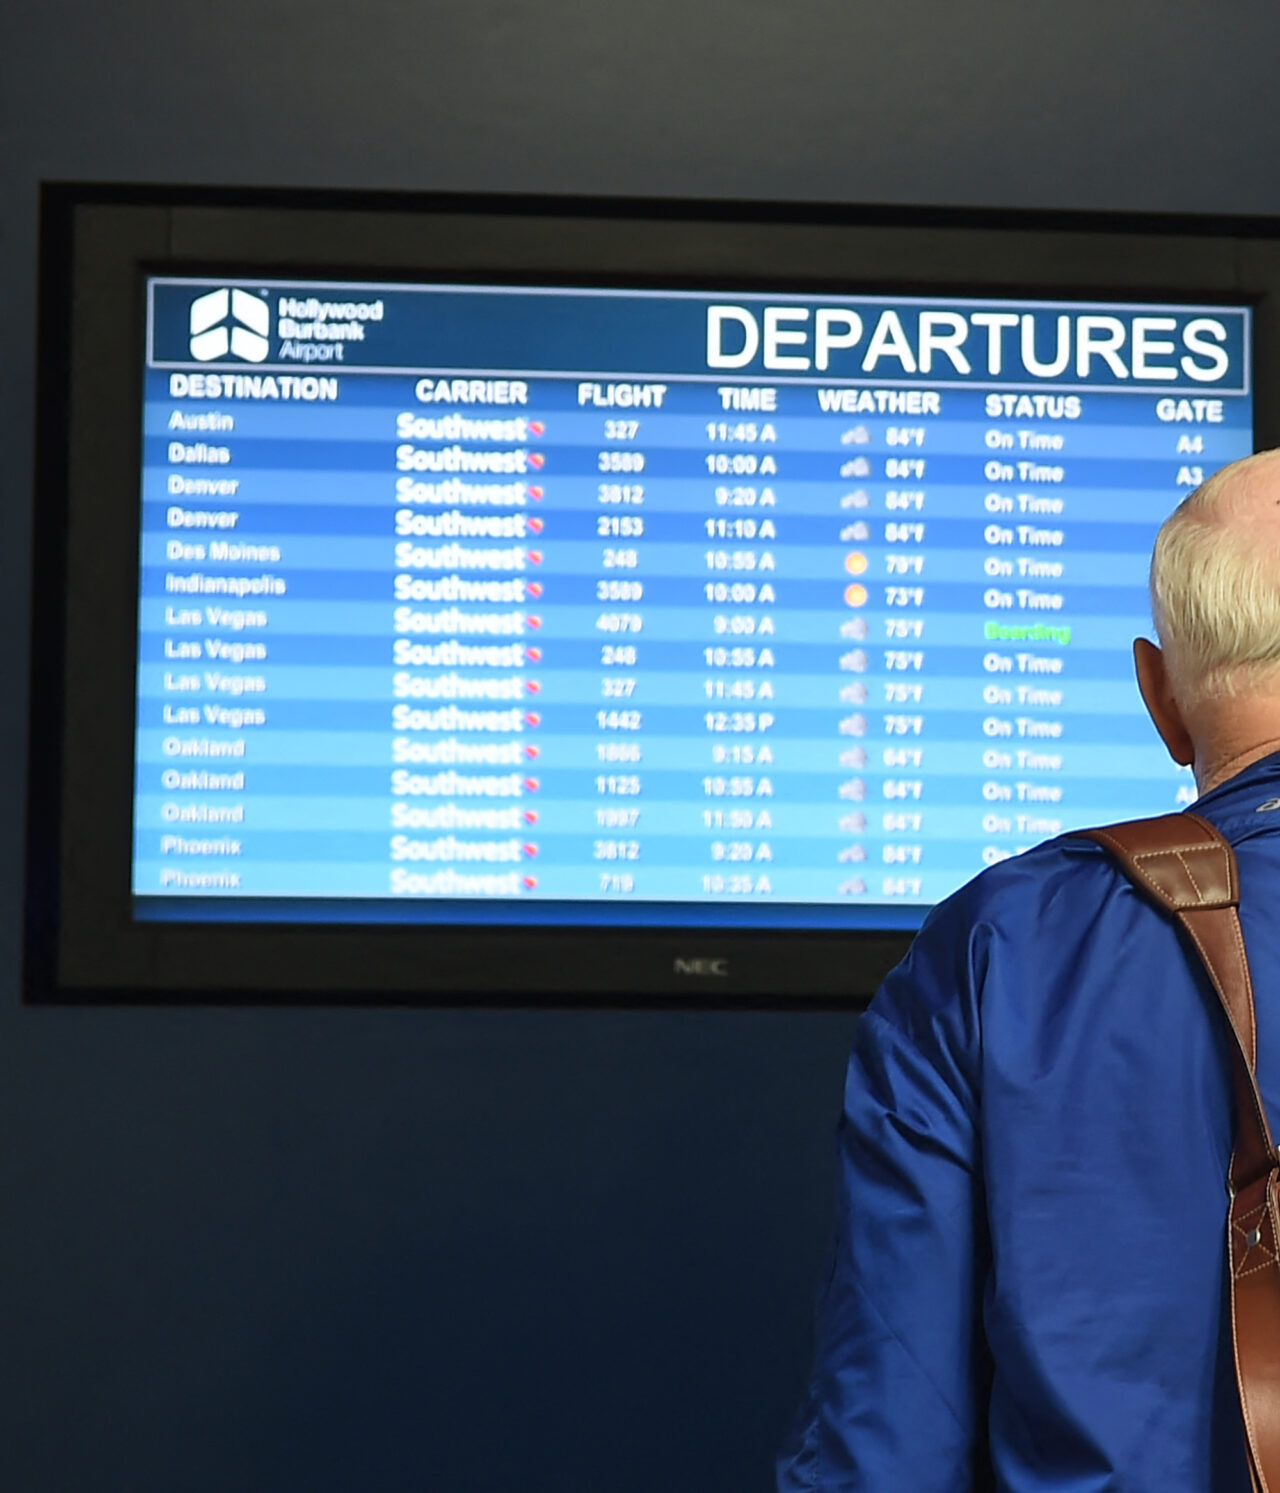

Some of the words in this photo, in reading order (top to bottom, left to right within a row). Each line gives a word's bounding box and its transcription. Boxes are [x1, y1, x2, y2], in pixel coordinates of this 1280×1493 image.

[279, 297, 384, 321] Hollywood
[278, 318, 365, 340] Burbank
[279, 339, 344, 362] Airport
[706, 304, 1229, 381] DEPARTURES
[171, 374, 337, 399] DESTINATION
[416, 380, 527, 403] CARRIER
[579, 383, 667, 407] FLIGHT
[718, 388, 776, 411] TIME
[818, 390, 940, 414] WEATHER
[986, 394, 1081, 418] STATUS
[1157, 399, 1223, 422] GATE
[169, 411, 234, 431] Austin
[398, 413, 525, 441] Southwest
[605, 420, 639, 440] 327
[707, 423, 757, 442] 11:45
[760, 424, 776, 442] A
[985, 429, 1014, 448] On
[1018, 430, 1064, 450] Time
[169, 442, 230, 463] Dallas
[1177, 435, 1203, 453] A4
[397, 445, 525, 473] Southwest
[707, 454, 757, 474] 10:00
[760, 456, 776, 474] A
[985, 461, 1014, 481] On
[1018, 462, 1064, 482] Time
[1178, 467, 1203, 486] A3
[168, 475, 239, 495] Denver
[397, 478, 525, 505] Southwest
[760, 488, 776, 506] A
[985, 493, 1013, 512] On
[1018, 494, 1064, 513] Time
[168, 507, 238, 528] Denver
[396, 510, 525, 537] Southwest
[759, 520, 775, 538] A
[984, 525, 1013, 544] On
[1017, 525, 1063, 545] Time
[167, 540, 206, 560] Des
[210, 541, 280, 562] Moines
[396, 542, 525, 570] Southwest
[984, 557, 1013, 576] On
[1017, 557, 1063, 577] Time
[166, 574, 286, 596] Indianapolis
[395, 574, 525, 602] Southwest
[166, 607, 202, 626] Las
[206, 607, 267, 630] Vegas
[395, 606, 525, 634] Southwest
[758, 616, 775, 634] A
[984, 622, 1071, 645] Boarding
[165, 640, 202, 659] Las
[205, 640, 266, 663] Vegas
[395, 639, 525, 667] Southwest
[984, 653, 1013, 672] On
[1016, 653, 1063, 673] Time
[165, 673, 201, 691] Las
[205, 673, 266, 696] Vegas
[394, 671, 525, 699] Southwest
[164, 706, 200, 724] Las
[204, 705, 265, 728] Vegas
[394, 704, 525, 732] Southwest
[759, 713, 774, 732] P
[983, 717, 1012, 736] On
[1016, 717, 1062, 737] Time
[163, 737, 245, 756] Oakland
[394, 736, 525, 764] Southwest
[162, 770, 244, 790] Oakland
[393, 769, 525, 797] Southwest
[162, 803, 243, 822] Oakland
[161, 835, 241, 854] Phoenix
[392, 834, 525, 862] Southwest
[161, 869, 240, 887] Phoenix
[673, 958, 728, 977] NEC
